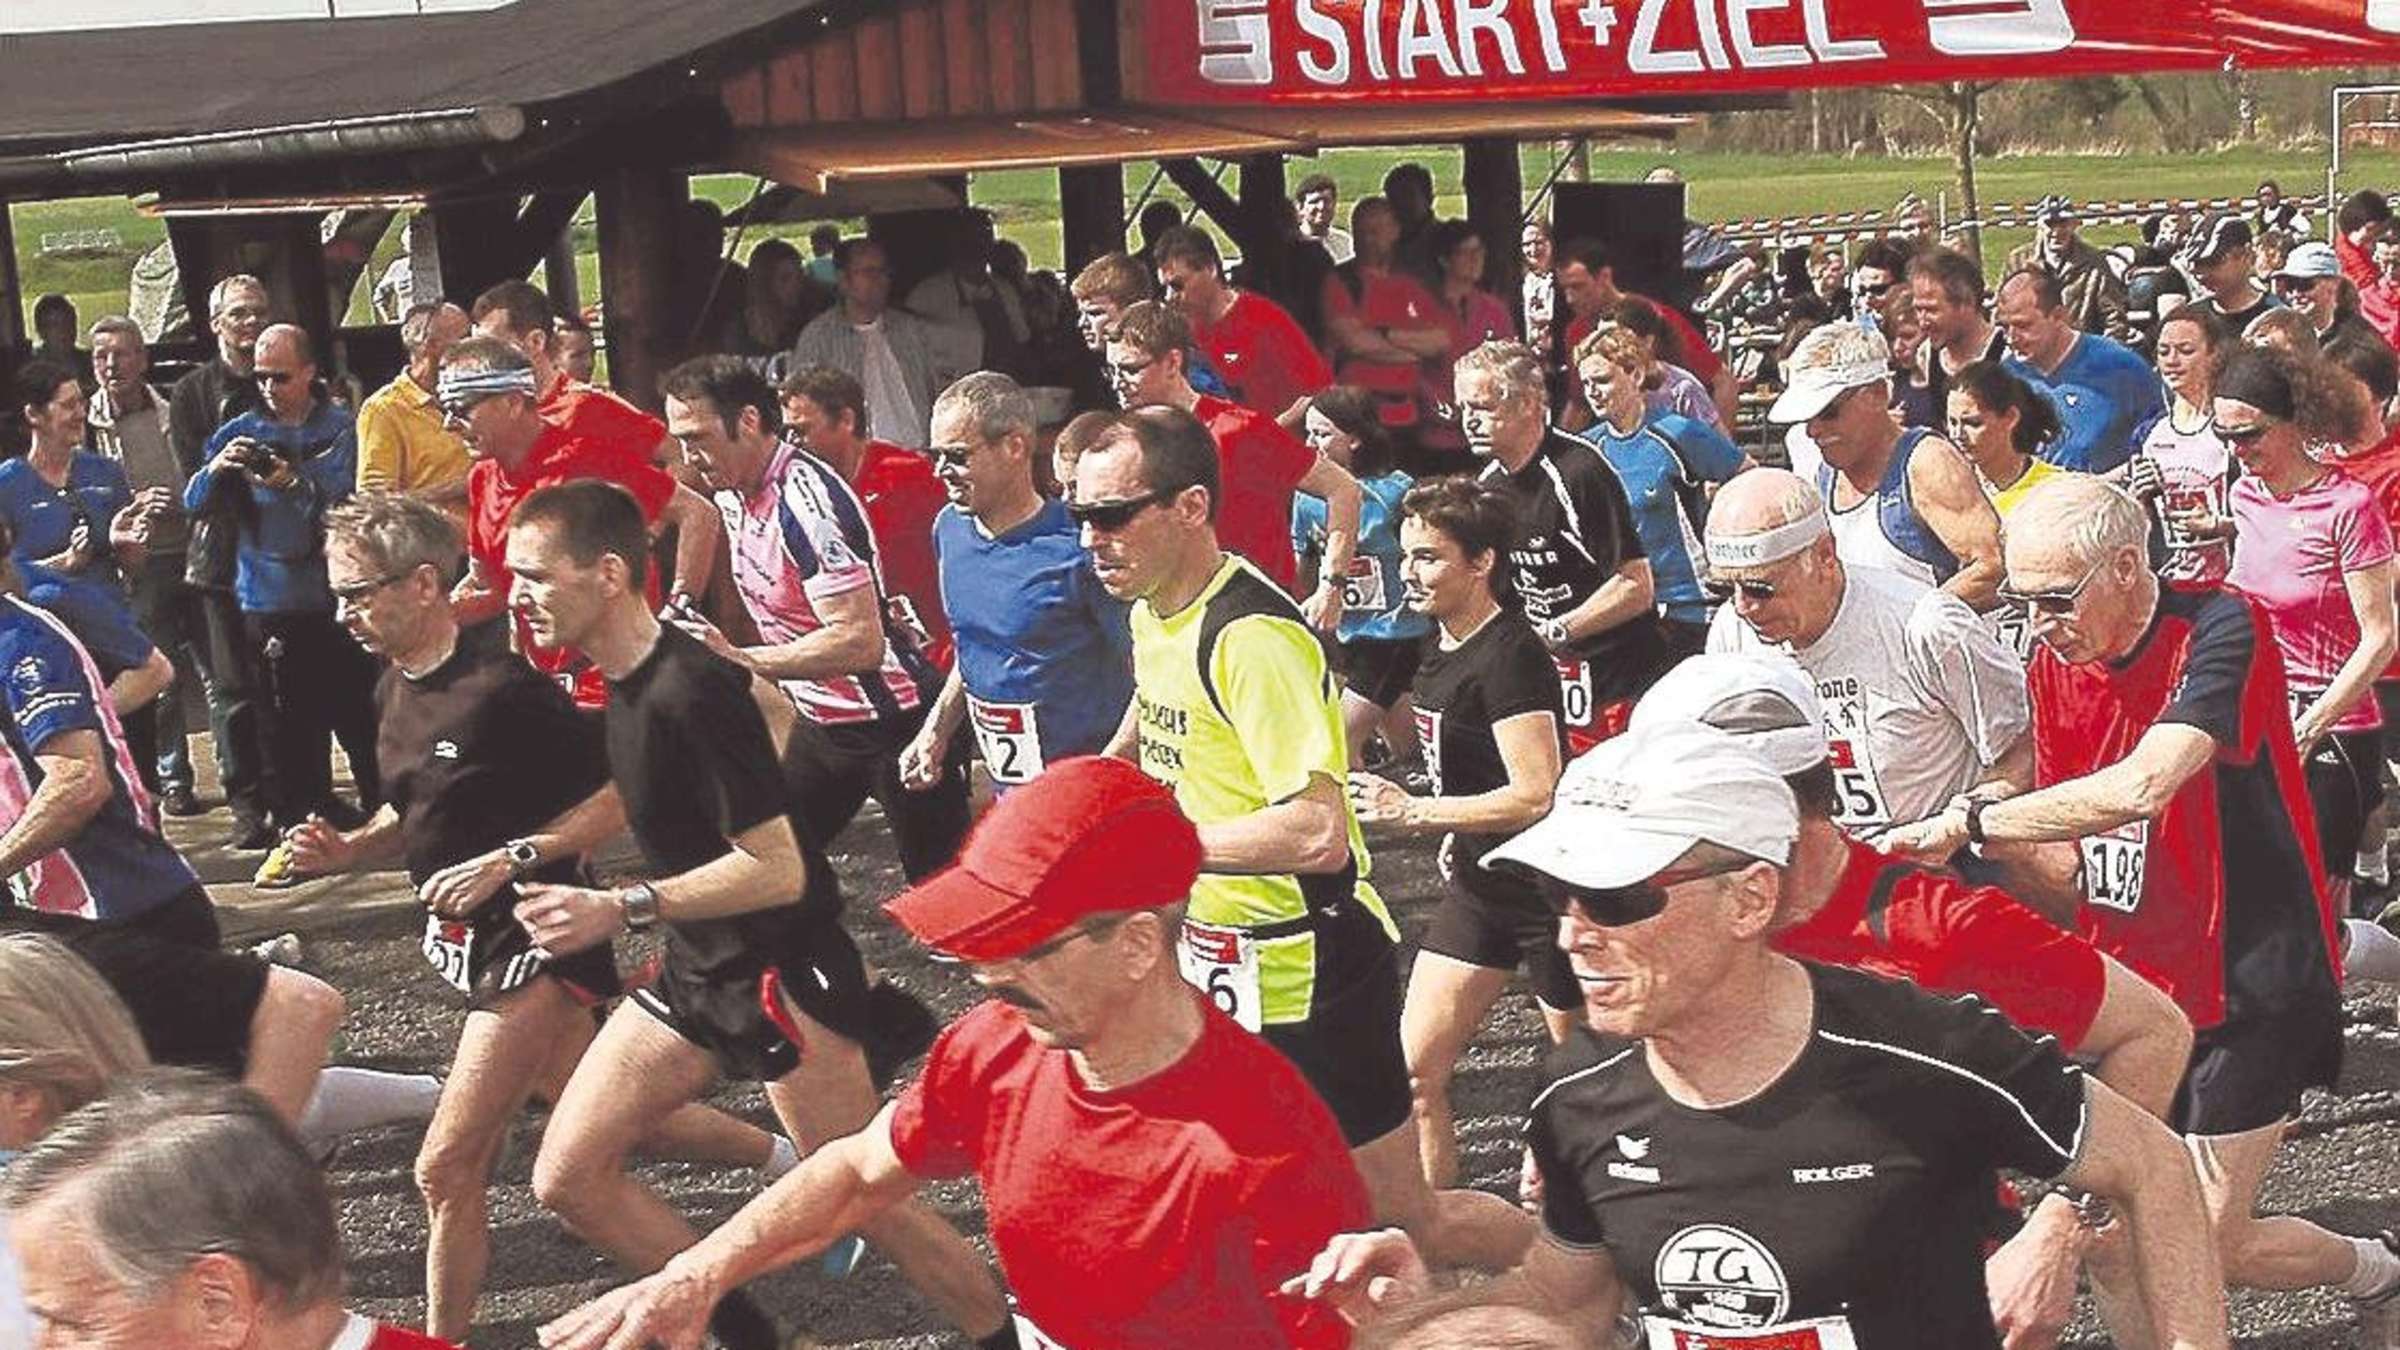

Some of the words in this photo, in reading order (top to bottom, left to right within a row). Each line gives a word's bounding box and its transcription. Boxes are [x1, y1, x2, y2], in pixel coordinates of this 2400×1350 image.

[2092, 843, 2143, 906] 198
[1792, 1164, 1874, 1183] HOLGER
[1679, 1247, 1754, 1285] TG
